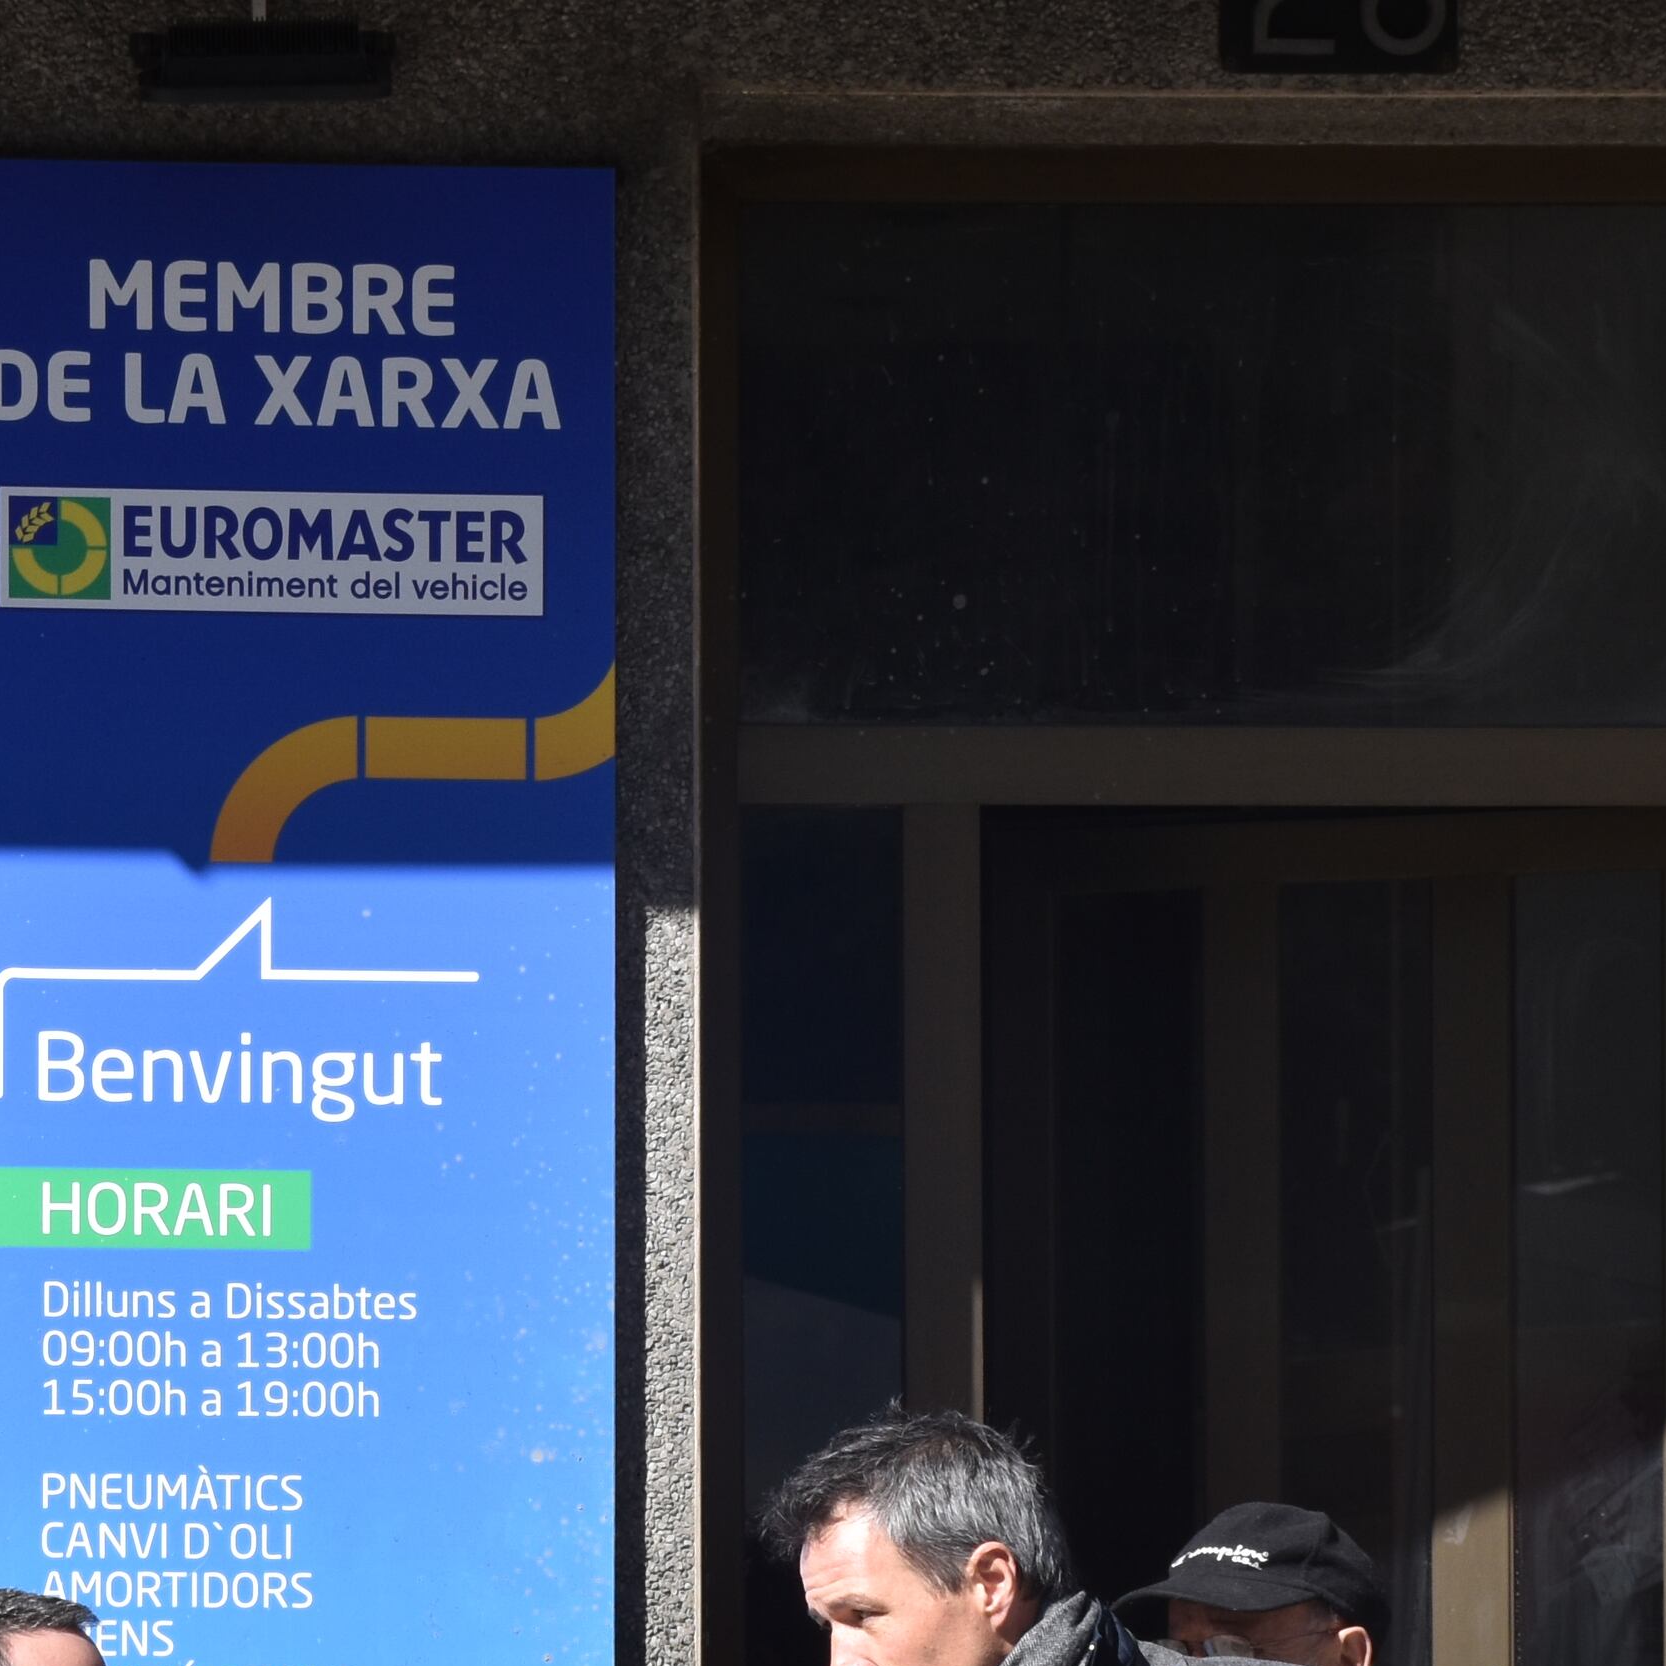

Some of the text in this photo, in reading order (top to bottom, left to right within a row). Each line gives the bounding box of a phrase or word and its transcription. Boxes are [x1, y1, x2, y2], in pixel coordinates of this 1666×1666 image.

[89, 259, 455, 336] MEMBRE
[124, 352, 226, 425] LA
[254, 355, 561, 430] XARXA
[122, 505, 528, 565] EUROMASTER
[122, 568, 528, 602] Manteniment del vehicle
[36, 1030, 443, 1123] Benvingut
[42, 1181, 272, 1237] HORARI
[43, 1280, 417, 1320] Dilluns a Dissabtes
[42, 1329, 380, 1369] 09:00h a 13:00h
[43, 1379, 380, 1418] 15:00h a 19:00h
[42, 1465, 303, 1511] PNEUMÀTICS
[41, 1521, 168, 1559] CANVI
[42, 1570, 313, 1609] AMORTIDORS
[85, 1620, 175, 1657] ENS
